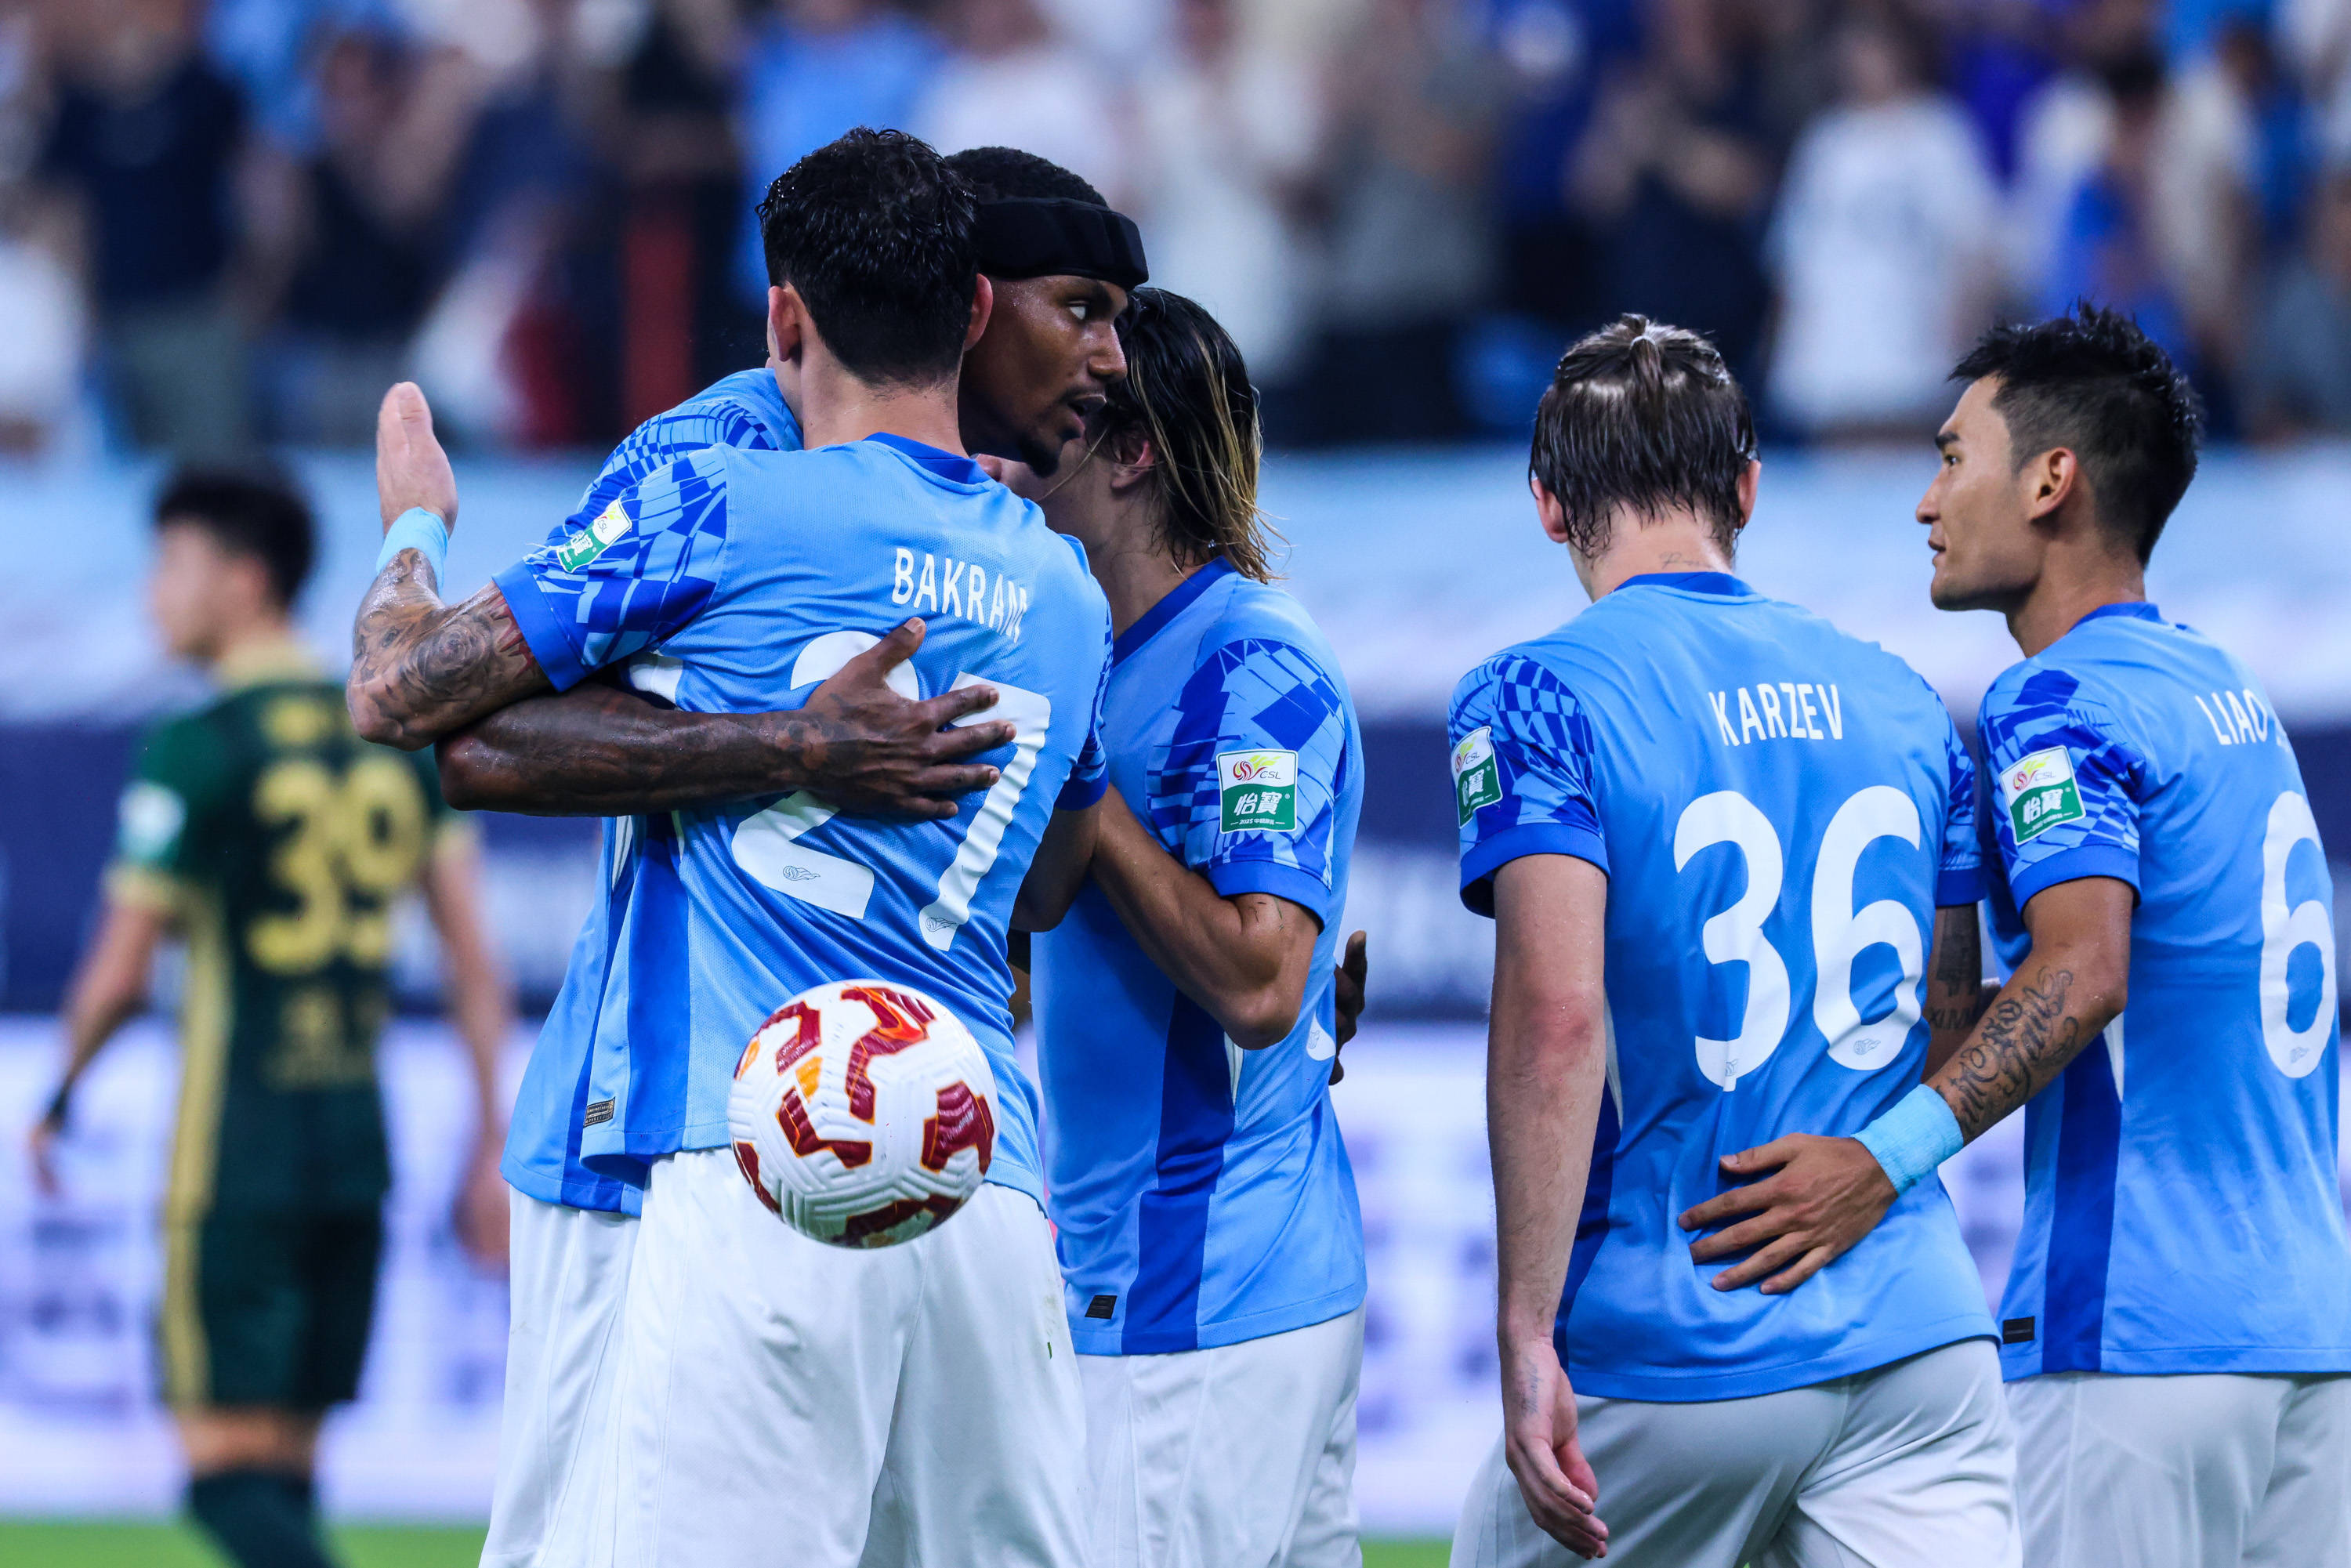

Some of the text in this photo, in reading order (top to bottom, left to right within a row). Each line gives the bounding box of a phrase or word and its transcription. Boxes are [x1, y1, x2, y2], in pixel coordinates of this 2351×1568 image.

[1708, 683, 1843, 747] KARZEV
[2195, 688, 2269, 745] LIAO
[731, 631, 1052, 951] 27
[1233, 791, 1283, 816] 怡寶
[1259, 770, 1281, 780] CSL
[2034, 770, 2056, 781] CSL
[245, 757, 428, 976] 39
[1673, 784, 1924, 1092] 36
[2259, 790, 2337, 1079] 6
